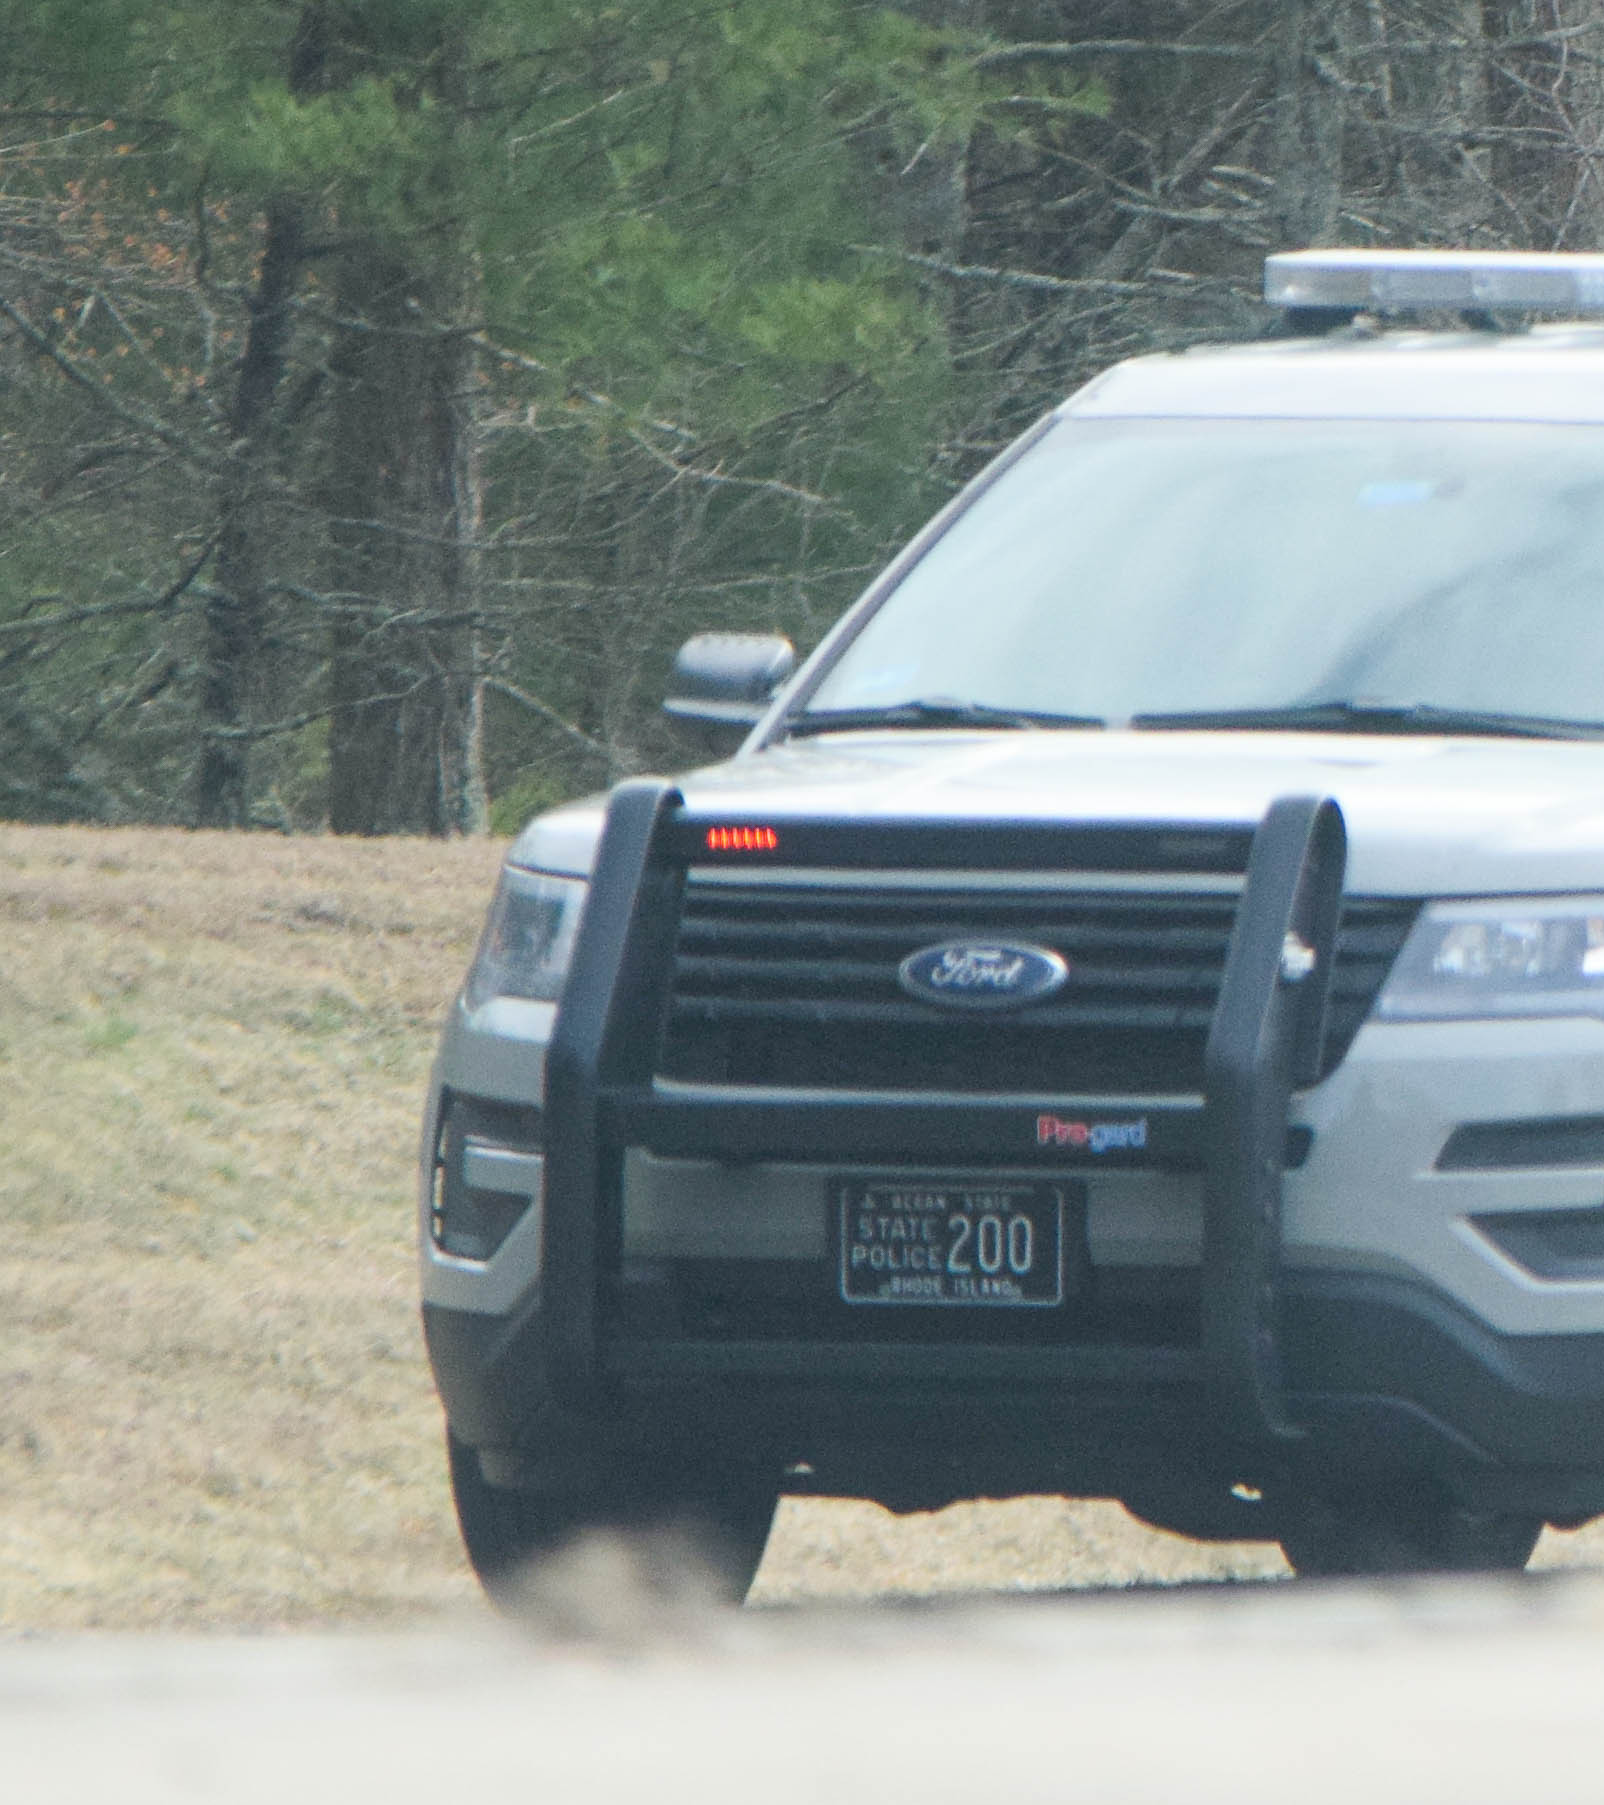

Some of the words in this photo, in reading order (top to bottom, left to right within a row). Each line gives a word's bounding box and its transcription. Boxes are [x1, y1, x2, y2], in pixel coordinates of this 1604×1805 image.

[931, 949, 1025, 987] Ford
[858, 1216, 938, 1241] STATE
[947, 1214, 1033, 1273] 200
[852, 1246, 942, 1270] POLICE
